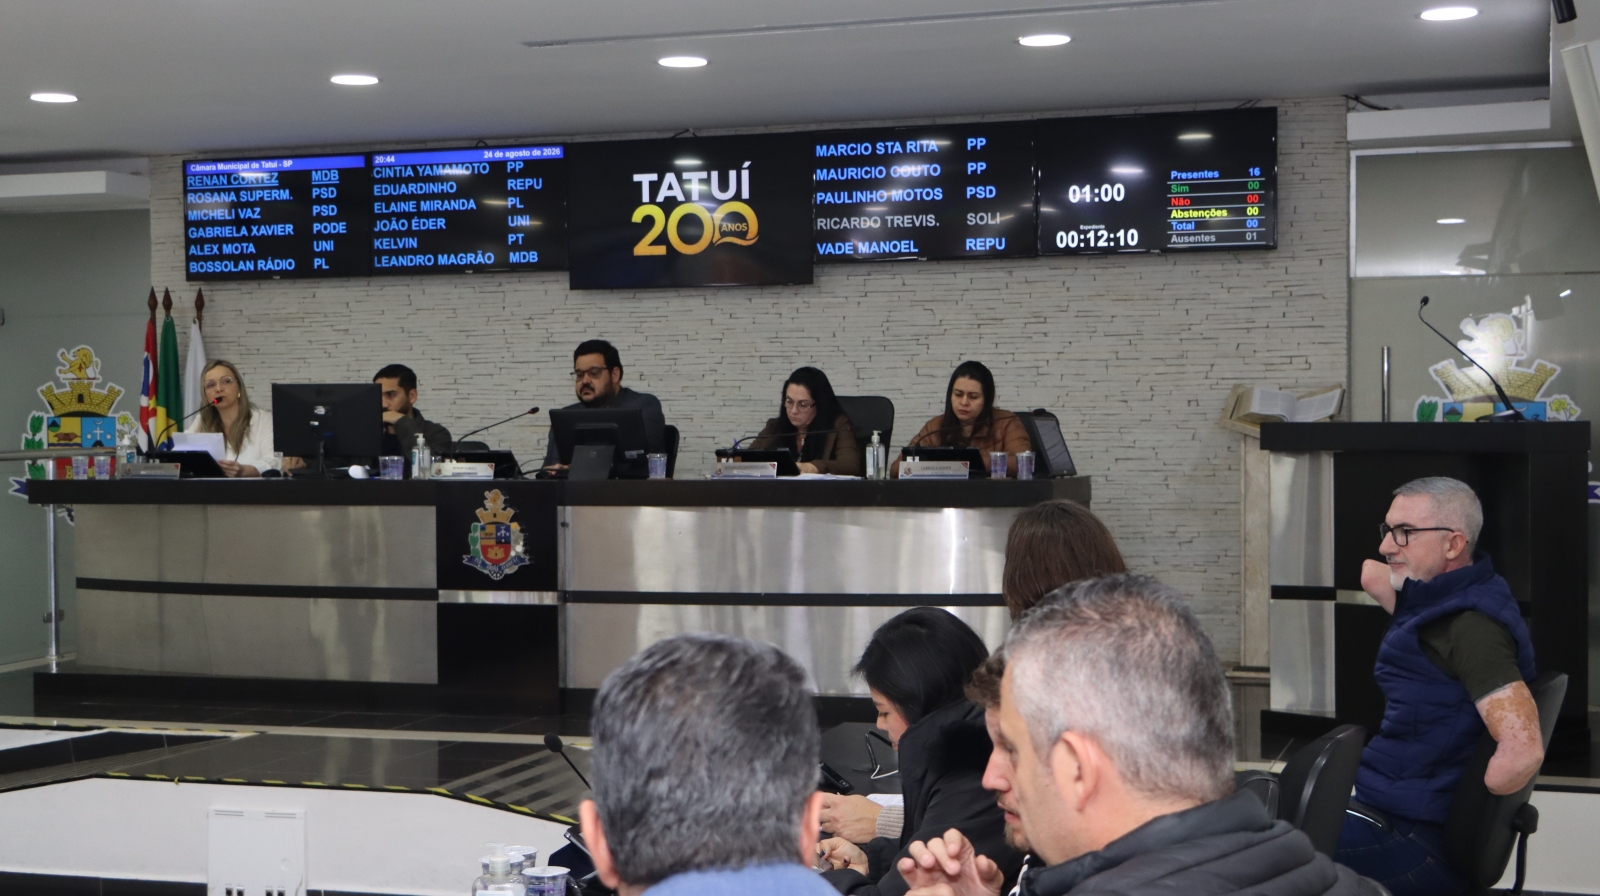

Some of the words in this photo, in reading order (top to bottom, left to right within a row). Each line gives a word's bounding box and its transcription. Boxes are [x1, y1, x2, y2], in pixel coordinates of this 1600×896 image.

[505, 150, 530, 159] agosto
[816, 142, 872, 157] MARCIO
[876, 141, 903, 154] STA
[906, 140, 938, 153] RITA
[967, 138, 986, 150] PP
[217, 162, 250, 171] Municipal
[375, 156, 395, 164] 20:44
[373, 166, 414, 178] CINTIA
[417, 162, 489, 176] YAMAMOTO
[507, 161, 524, 173] PP
[816, 166, 886, 181] MAURICIO
[890, 164, 941, 178] COUTO
[967, 162, 986, 175] PP
[1171, 170, 1219, 180] Presentes
[1249, 167, 1260, 177] 16
[187, 175, 227, 187] RENAN
[230, 172, 279, 185] CORTEZ
[312, 170, 339, 182] MDB
[374, 181, 457, 196] EDUARDINHO
[508, 178, 542, 190] REPU
[633, 161, 752, 203] TATUÍ
[1171, 184, 1189, 193] Sim
[1248, 181, 1259, 190] 00
[187, 192, 237, 204] ROSANA
[240, 189, 293, 202] SUPERM.
[312, 187, 337, 198] PSD
[816, 190, 887, 204] PAULINHO
[891, 188, 943, 202] MOTOS
[966, 186, 996, 199] PSD
[1068, 183, 1125, 203] 01:00
[1171, 197, 1191, 206] Não
[1247, 194, 1259, 204] 00
[188, 209, 235, 221] MICHELI
[238, 208, 261, 219] VAZ
[312, 205, 337, 216] PSD
[374, 201, 417, 213] ELAINE
[420, 199, 477, 212] MIRANDA
[508, 197, 524, 208] PL
[1171, 208, 1228, 219] Abstenções
[1247, 207, 1259, 216] 00
[374, 218, 408, 232] JOÃO
[412, 216, 446, 230] ÉDER
[508, 215, 530, 227] UNI
[632, 200, 759, 256] 200
[721, 222, 748, 232] ANOS
[817, 216, 881, 230] RICARDO
[886, 214, 940, 228] TREVIS.
[967, 212, 1000, 225] SOLI
[1171, 221, 1195, 231] Total
[1246, 219, 1258, 228] 00
[188, 226, 248, 239] GABRIELA
[251, 224, 294, 236] XAVIER
[313, 222, 347, 234] PODE
[1056, 229, 1138, 248] 00:12:10
[1171, 233, 1216, 243] Ausentes
[1246, 232, 1257, 241] 01
[189, 244, 219, 256] ALEX
[222, 242, 256, 255] MOTA
[313, 240, 334, 252] UNI
[374, 237, 418, 249] KELVIN
[508, 234, 524, 245] PT
[817, 242, 854, 255] VADE
[858, 240, 918, 254] MANOEL
[966, 238, 1006, 251] REPU
[190, 260, 254, 273] BOSSOLAN
[257, 257, 295, 271] RÁDIO
[314, 258, 329, 269] PL
[374, 254, 434, 268] LEANDRO
[438, 251, 494, 265] MAGRÃO
[509, 251, 538, 263] MDB
